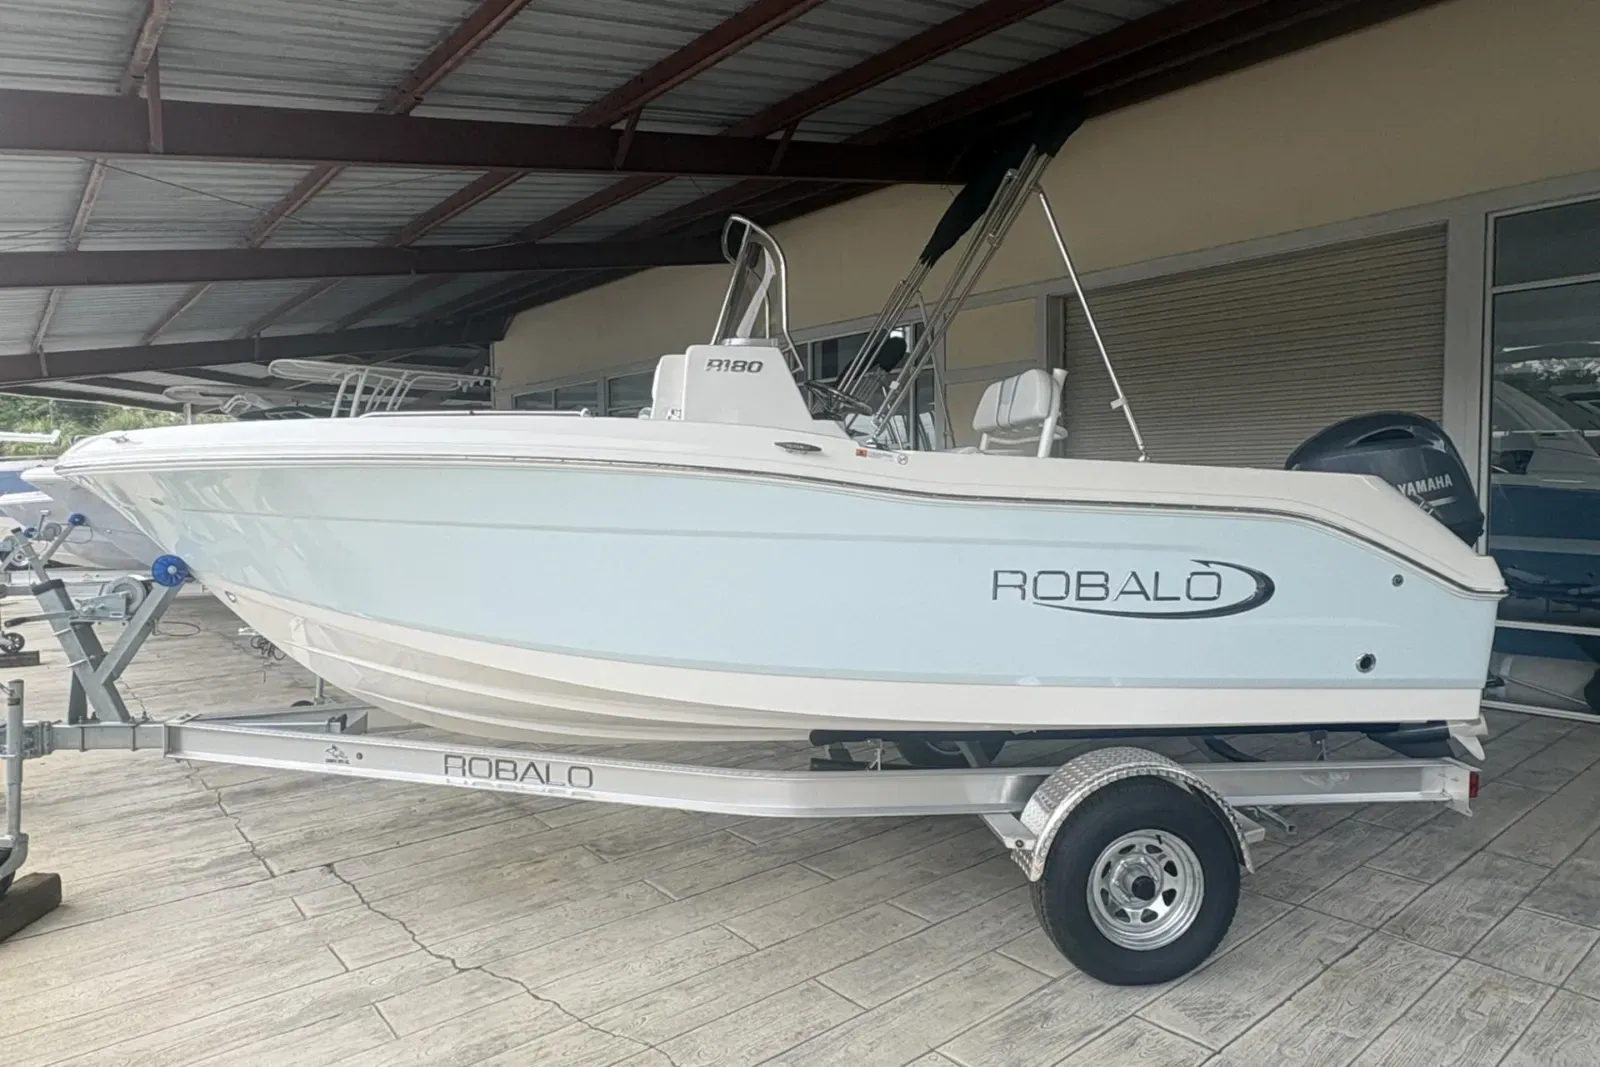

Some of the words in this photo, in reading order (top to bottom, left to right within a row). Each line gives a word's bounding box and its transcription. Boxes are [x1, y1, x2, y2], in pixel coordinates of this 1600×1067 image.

[705, 359, 764, 373] R180
[1397, 473, 1453, 497] YAMAHA
[992, 570, 1222, 601] ROBALO
[444, 754, 593, 788] ROBALO
